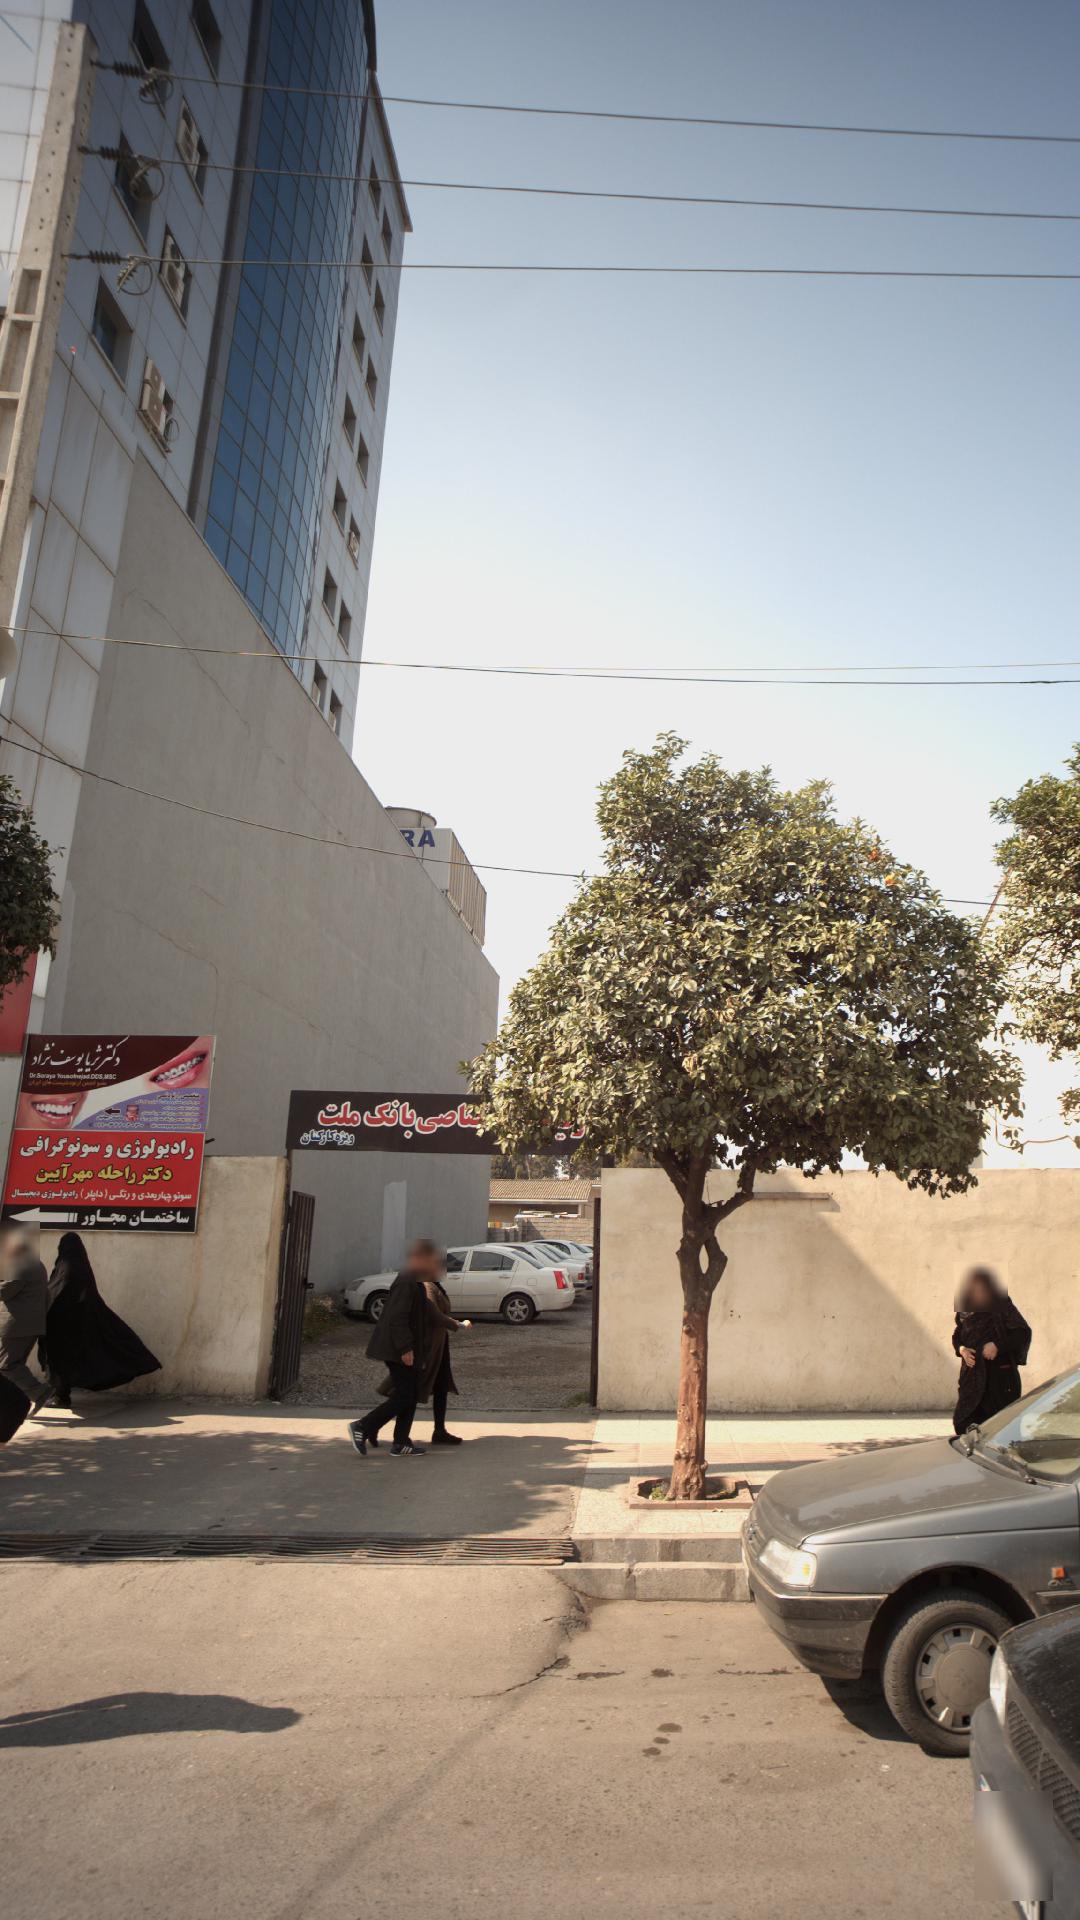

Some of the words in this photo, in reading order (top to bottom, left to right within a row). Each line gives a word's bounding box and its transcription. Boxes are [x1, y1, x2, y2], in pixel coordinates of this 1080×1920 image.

[95, 1034, 130, 1071] دکتر
[317, 1101, 362, 1127] ملت
[363, 1099, 416, 1139] بانک
[300, 1129, 335, 1146] کارکنان
[334, 1130, 356, 1146] ویژه
[20, 1135, 100, 1159] سونوگرافی
[103, 1144, 113, 1158] و
[116, 1138, 195, 1160] رادیولوژی
[97, 1164, 137, 1184] راحله
[138, 1166, 173, 1185] دکتر
[42, 1189, 79, 1200] رادیولوژی
[109, 1189, 131, 1201] رنگی
[81, 1208, 127, 1226] مجاور
[128, 1208, 190, 1226] ساختمان
